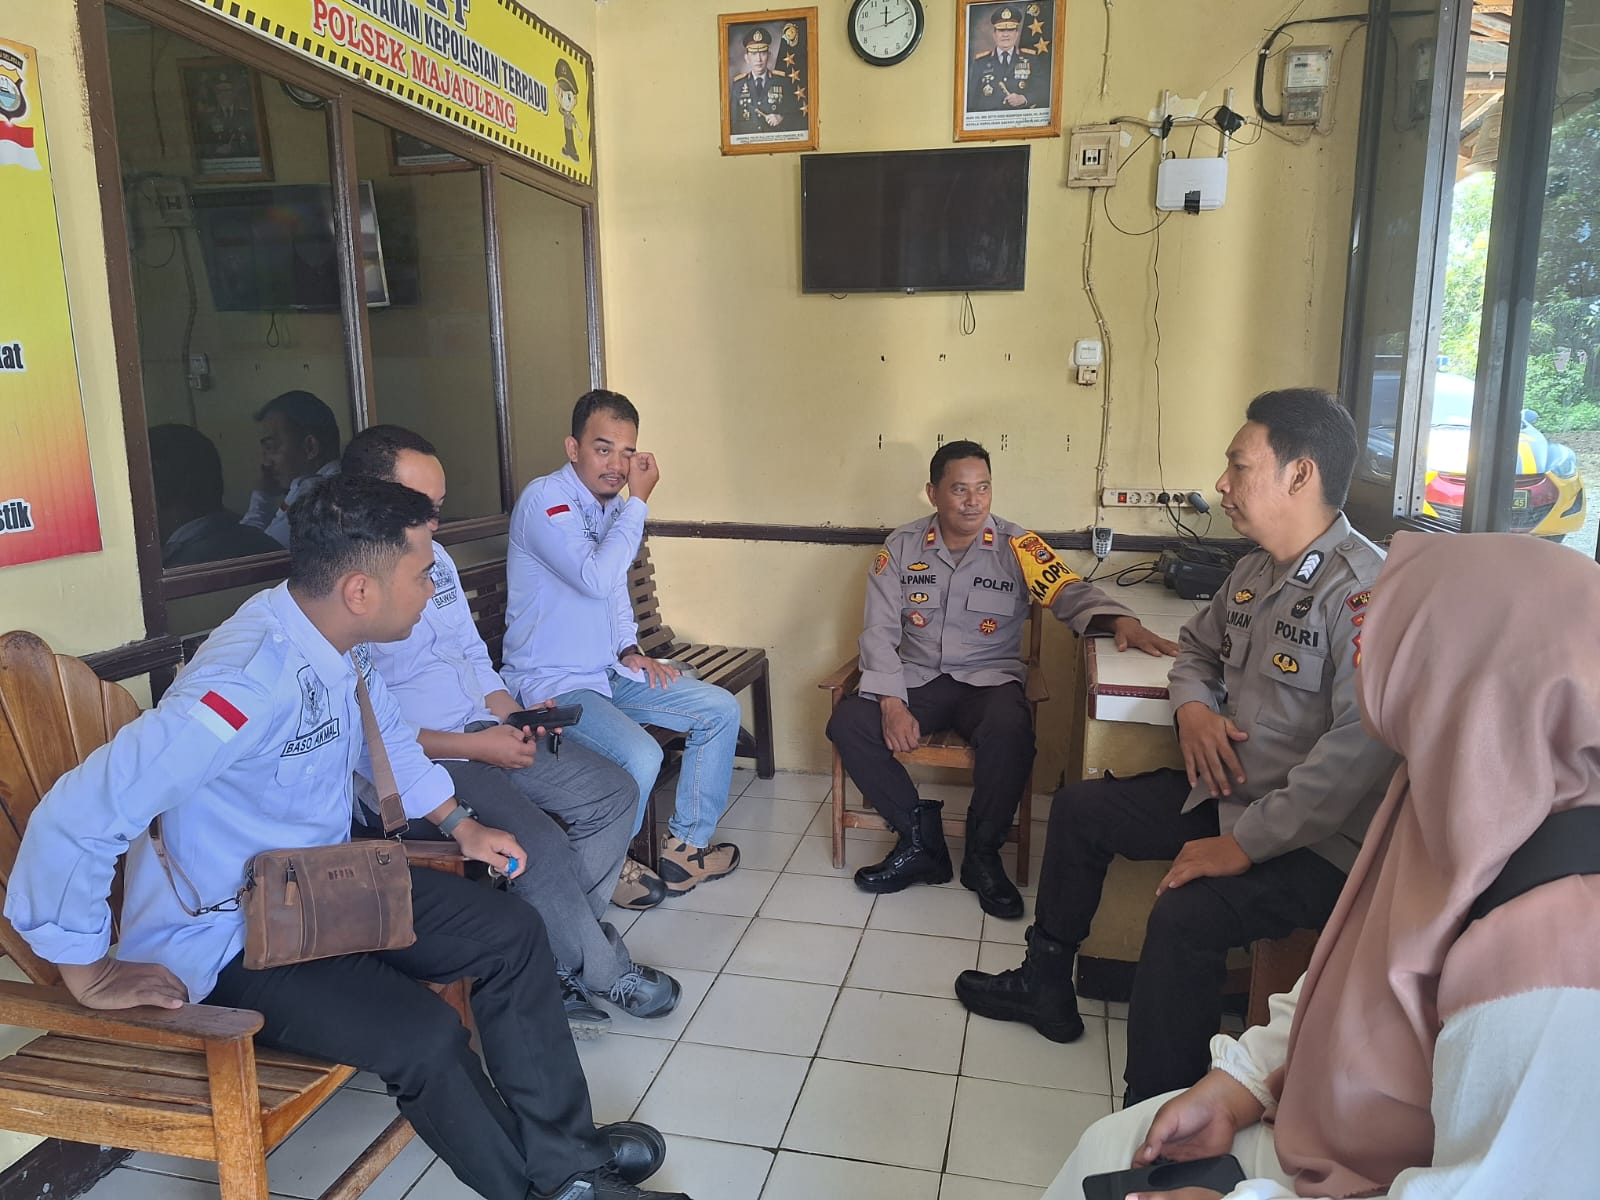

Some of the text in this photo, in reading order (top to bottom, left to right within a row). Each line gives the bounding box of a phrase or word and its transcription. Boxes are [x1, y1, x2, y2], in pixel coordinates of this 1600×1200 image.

[313, 0, 516, 129] POLSEK MAJAULENG
[424, 12, 499, 84] KEPOLISIAN
[501, 60, 547, 112] TERPADU
[973, 576, 1015, 592] POLRI
[1030, 579, 1050, 601] KA
[1274, 620, 1319, 647] POLRI
[286, 722, 337, 754] BASO AKMAL
